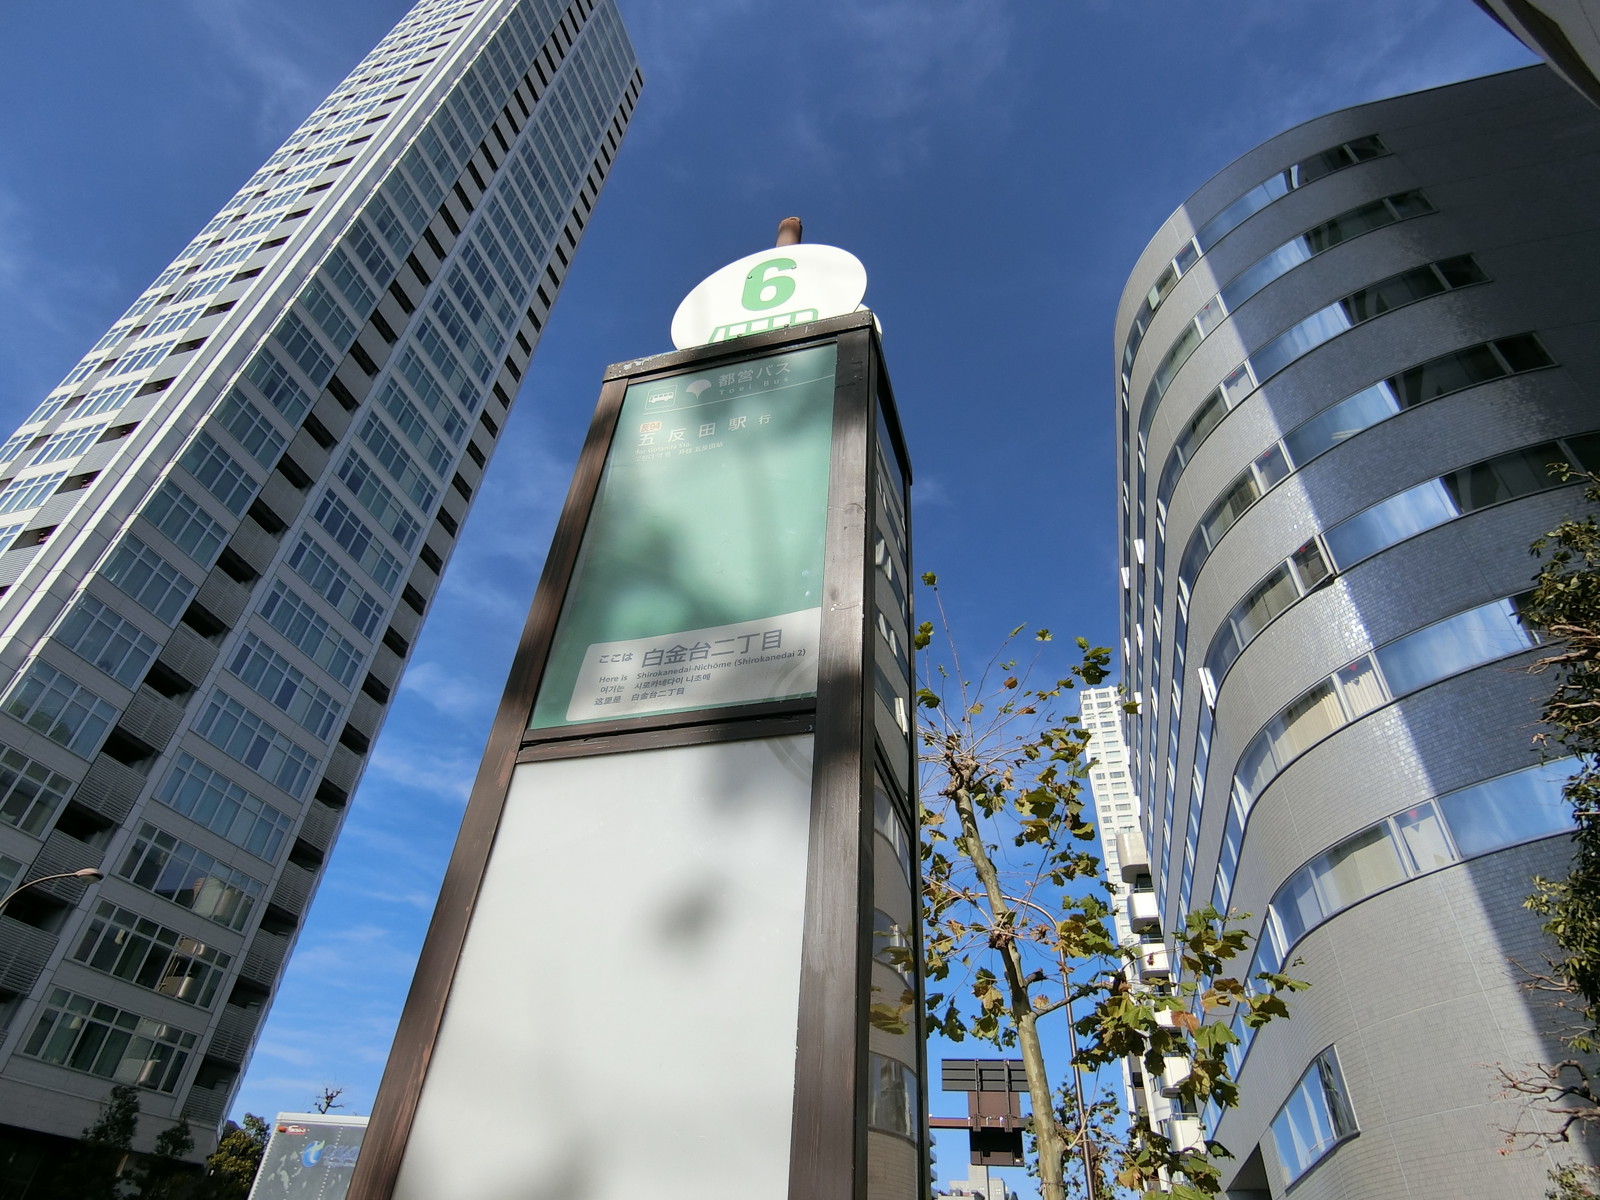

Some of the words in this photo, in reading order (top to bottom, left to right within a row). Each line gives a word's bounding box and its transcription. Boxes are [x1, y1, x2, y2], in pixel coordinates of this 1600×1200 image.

[741, 257, 797, 312] 6
[719, 362, 791, 388] 都営バス
[720, 383, 753, 396] Toei
[763, 377, 790, 388] Bus
[599, 652, 634, 664] ここは
[641, 629, 783, 668] 白金台二丁目
[599, 675, 619, 683] Here
[620, 674, 628, 682] is
[733, 650, 796, 670] (Shirokanedai
[797, 648, 806, 658] 2)
[600, 685, 625, 694] 여기는
[630, 687, 685, 702] 白金台二丁目
